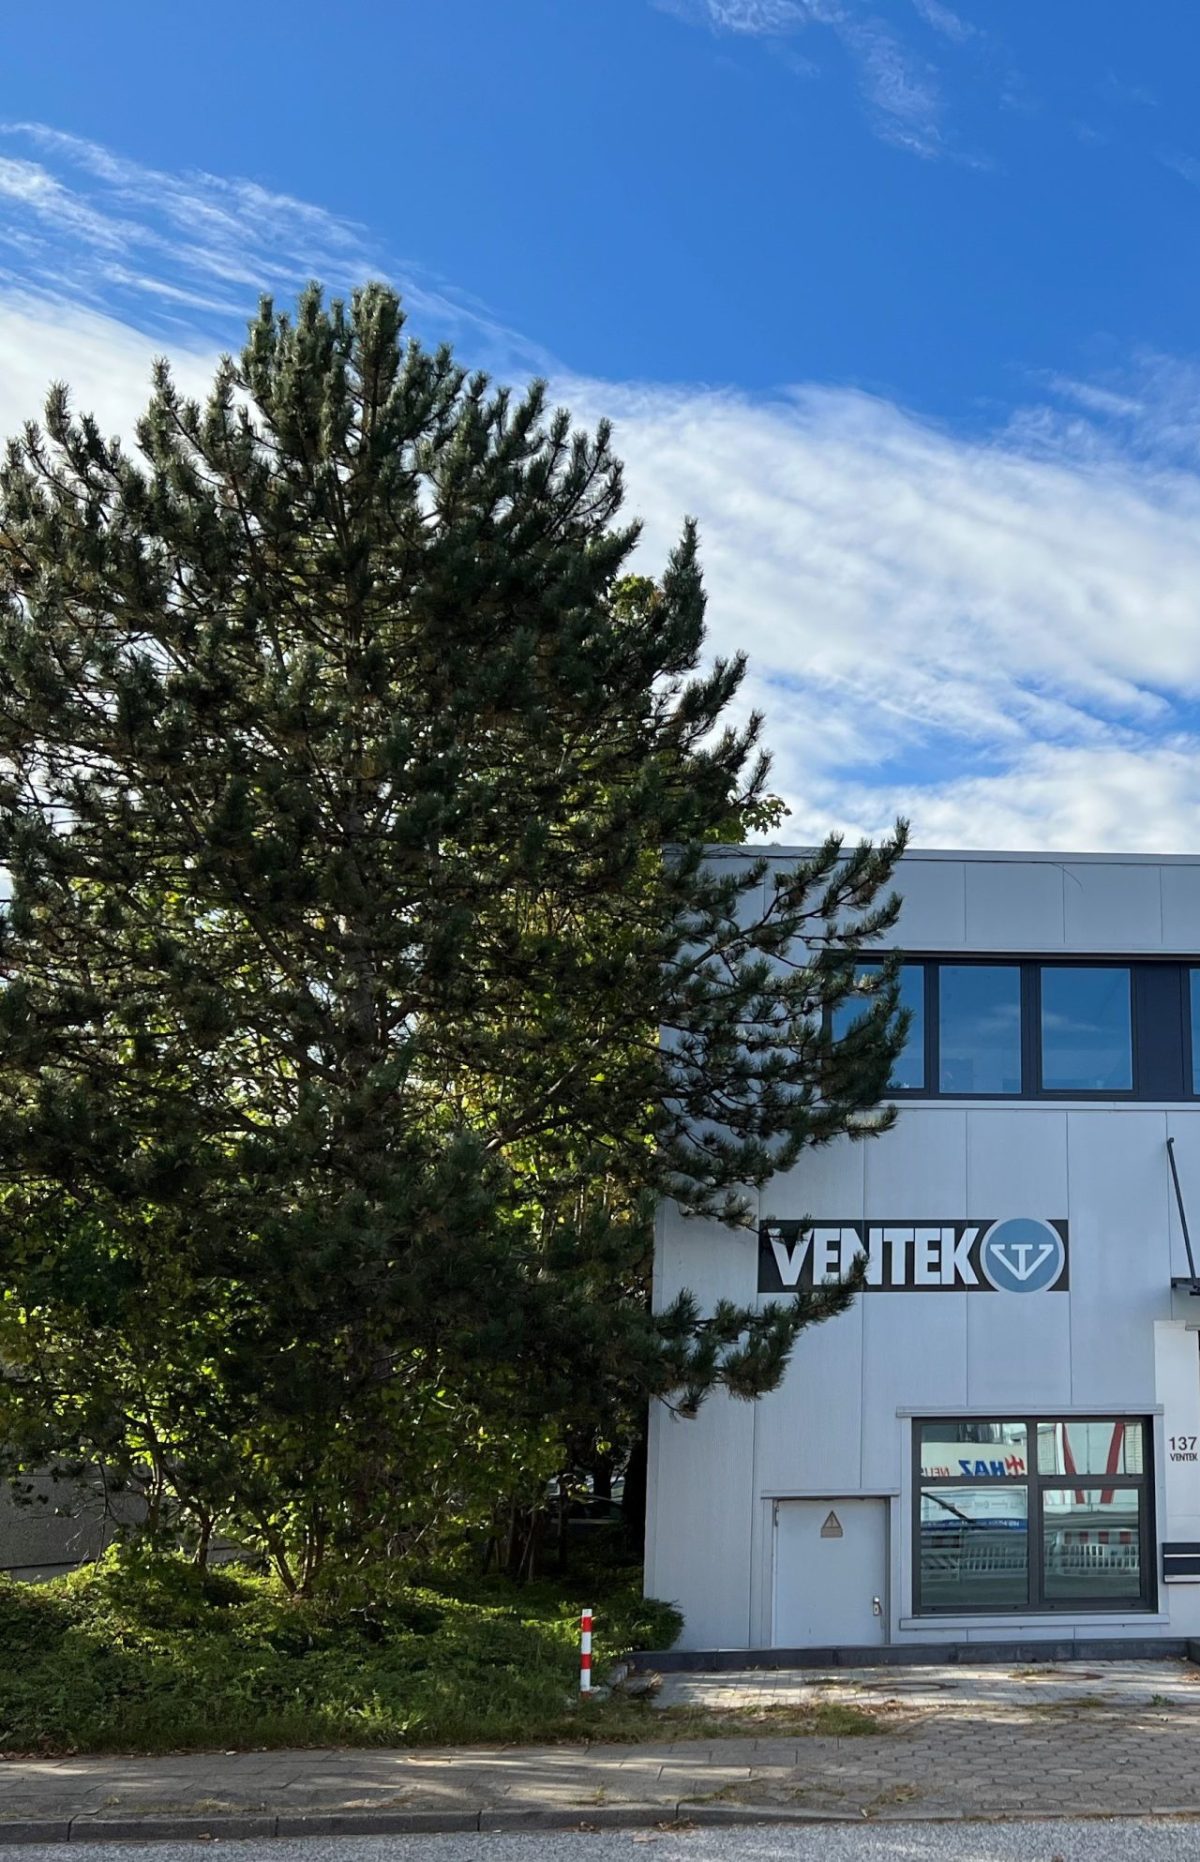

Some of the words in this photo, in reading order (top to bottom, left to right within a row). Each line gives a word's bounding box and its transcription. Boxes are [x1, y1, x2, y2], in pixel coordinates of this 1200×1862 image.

[768, 1227, 980, 1286] VENTEK
[1169, 1436, 1198, 1451] 137
[1170, 1453, 1199, 1462] VENTEK
